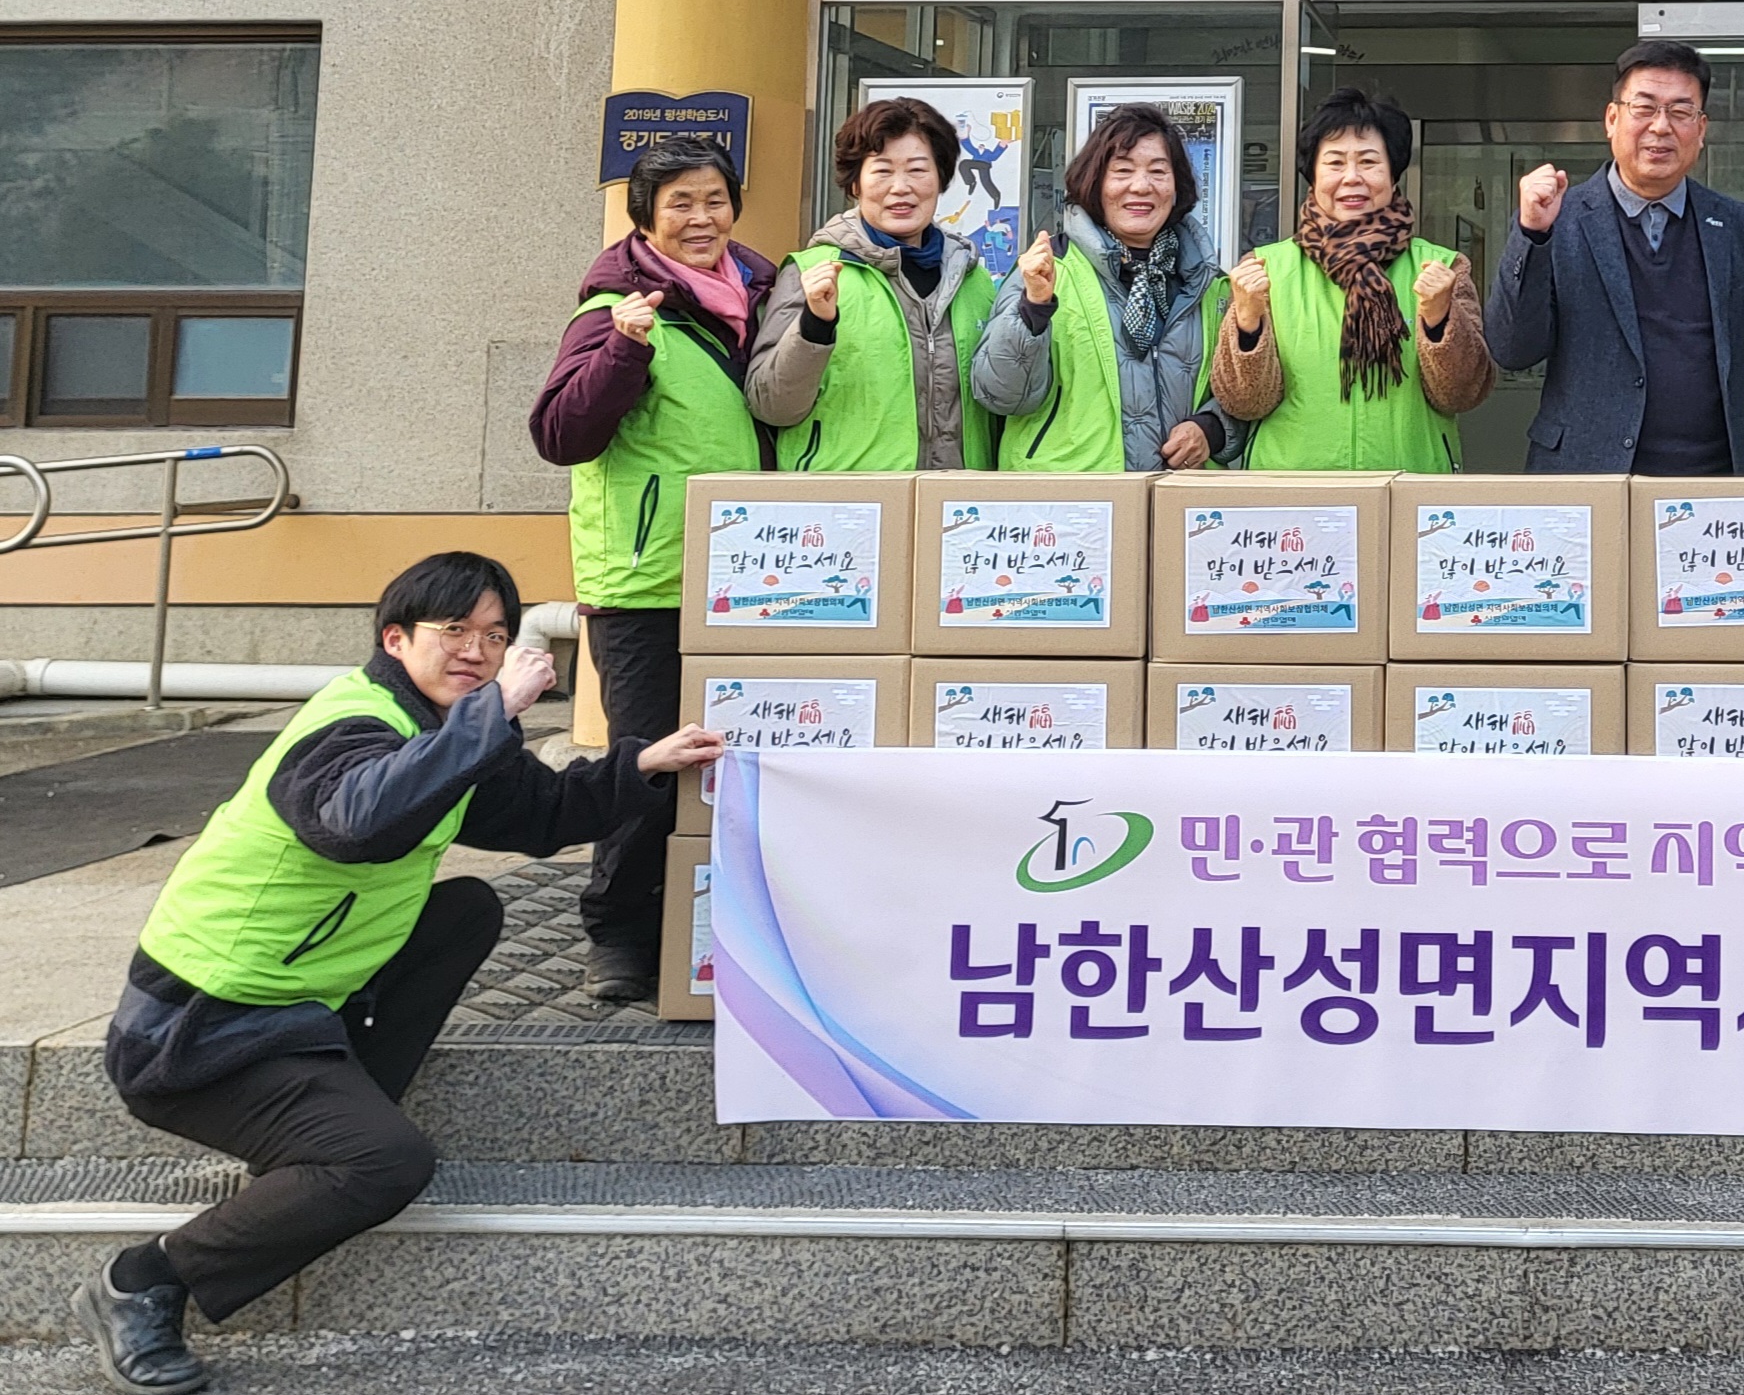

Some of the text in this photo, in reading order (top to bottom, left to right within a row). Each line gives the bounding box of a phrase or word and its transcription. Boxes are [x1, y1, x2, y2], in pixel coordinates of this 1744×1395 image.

[623, 108, 729, 122] 2019년 평생학습도시
[731, 551, 857, 574] 많이 받으세요
[963, 550, 1090, 574] 많이 받으세요
[1207, 555, 1340, 581] 많이 받으세요
[1440, 555, 1570, 579] 많이 받으세요
[1679, 547, 1717, 573] 많이
[733, 597, 773, 606] 남한산성면
[966, 597, 1005, 606] 남한산성면
[1212, 605, 1253, 614] 남한산성면
[1443, 603, 1484, 612] 남한산성면
[1685, 596, 1728, 606] 남한산성면
[1182, 816, 1338, 883] 민·관
[1358, 815, 1632, 887] 협력으로
